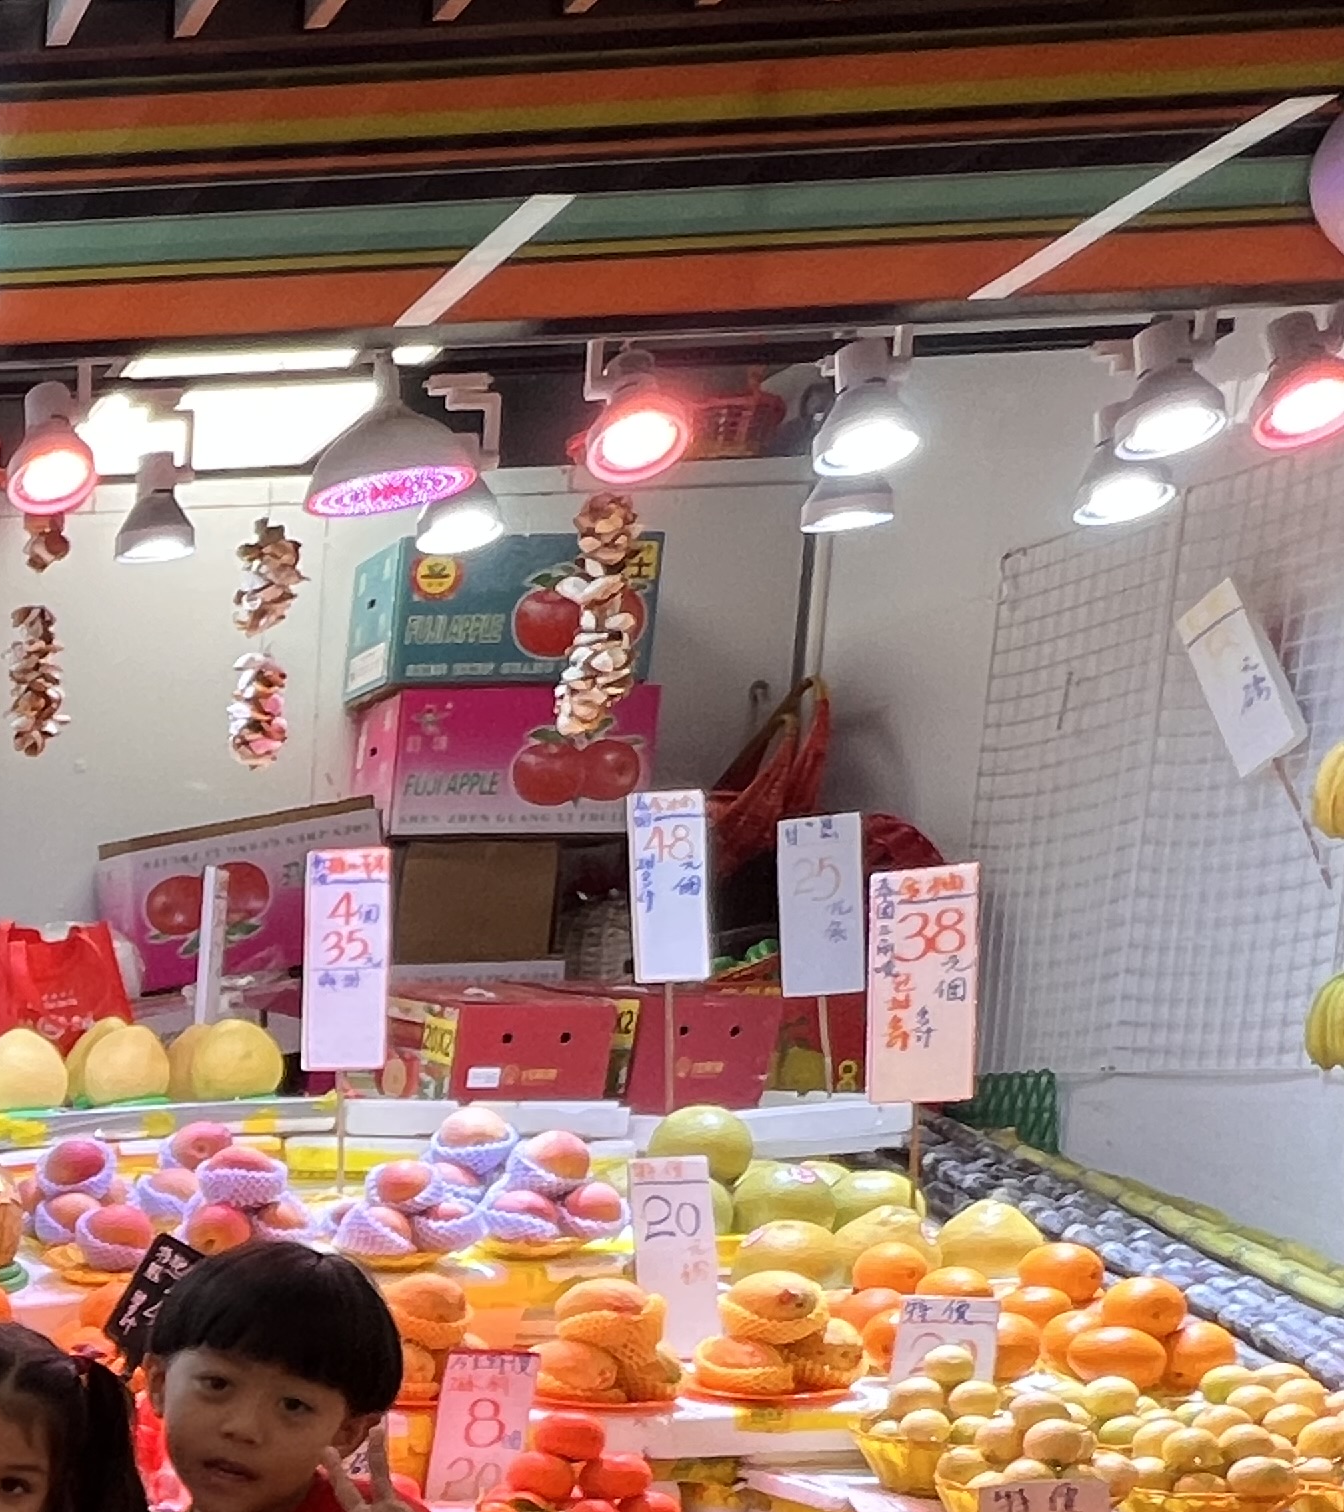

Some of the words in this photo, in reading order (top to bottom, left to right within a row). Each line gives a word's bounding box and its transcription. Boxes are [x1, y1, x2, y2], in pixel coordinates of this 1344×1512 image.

[405, 615, 448, 645] FUJI
[449, 613, 506, 644] APPLE
[404, 774, 443, 797] FUJI
[445, 772, 500, 796] APPLE
[643, 824, 695, 863] 48
[792, 855, 843, 902] 25
[893, 906, 966, 962] 38
[641, 1194, 701, 1242] 20
[439, 1456, 502, 1501] 20
